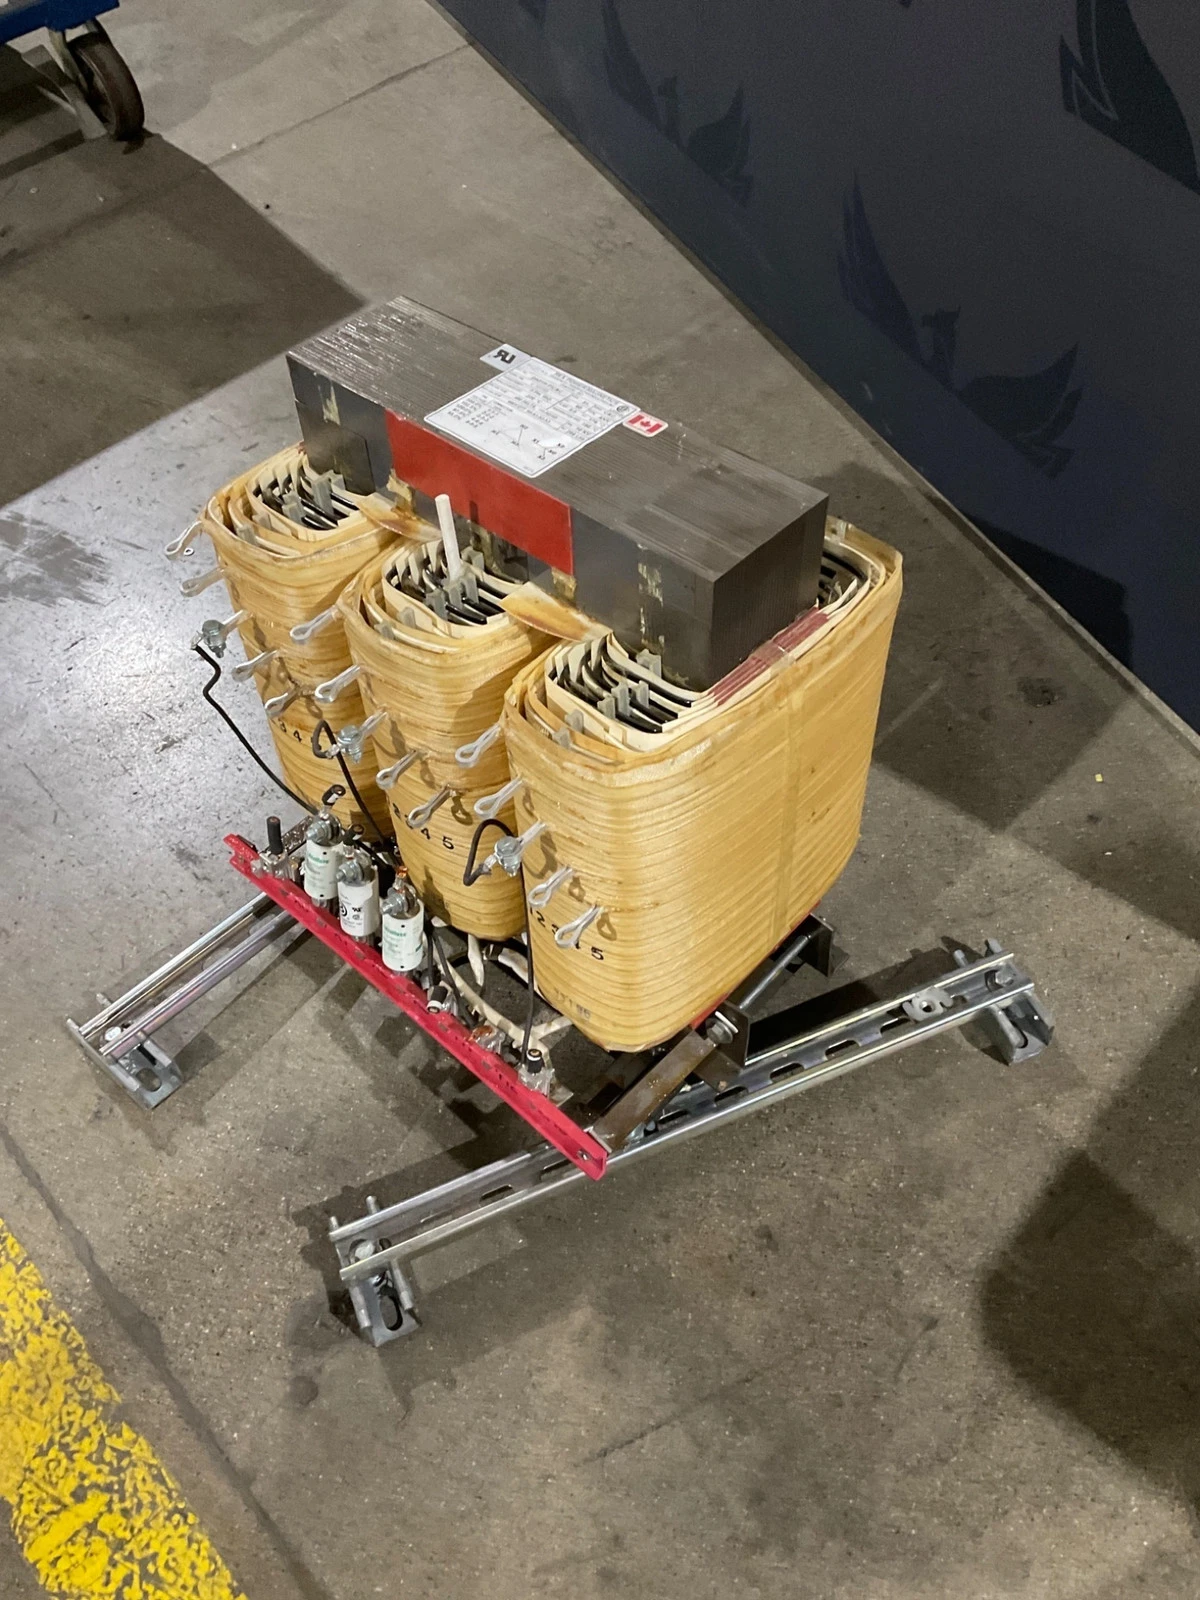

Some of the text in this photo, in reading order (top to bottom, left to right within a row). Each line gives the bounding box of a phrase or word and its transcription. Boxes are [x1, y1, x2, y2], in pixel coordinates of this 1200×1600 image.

[421, 828, 431, 840] 4
[442, 836, 455, 850] 5
[591, 946, 605, 961] 5
